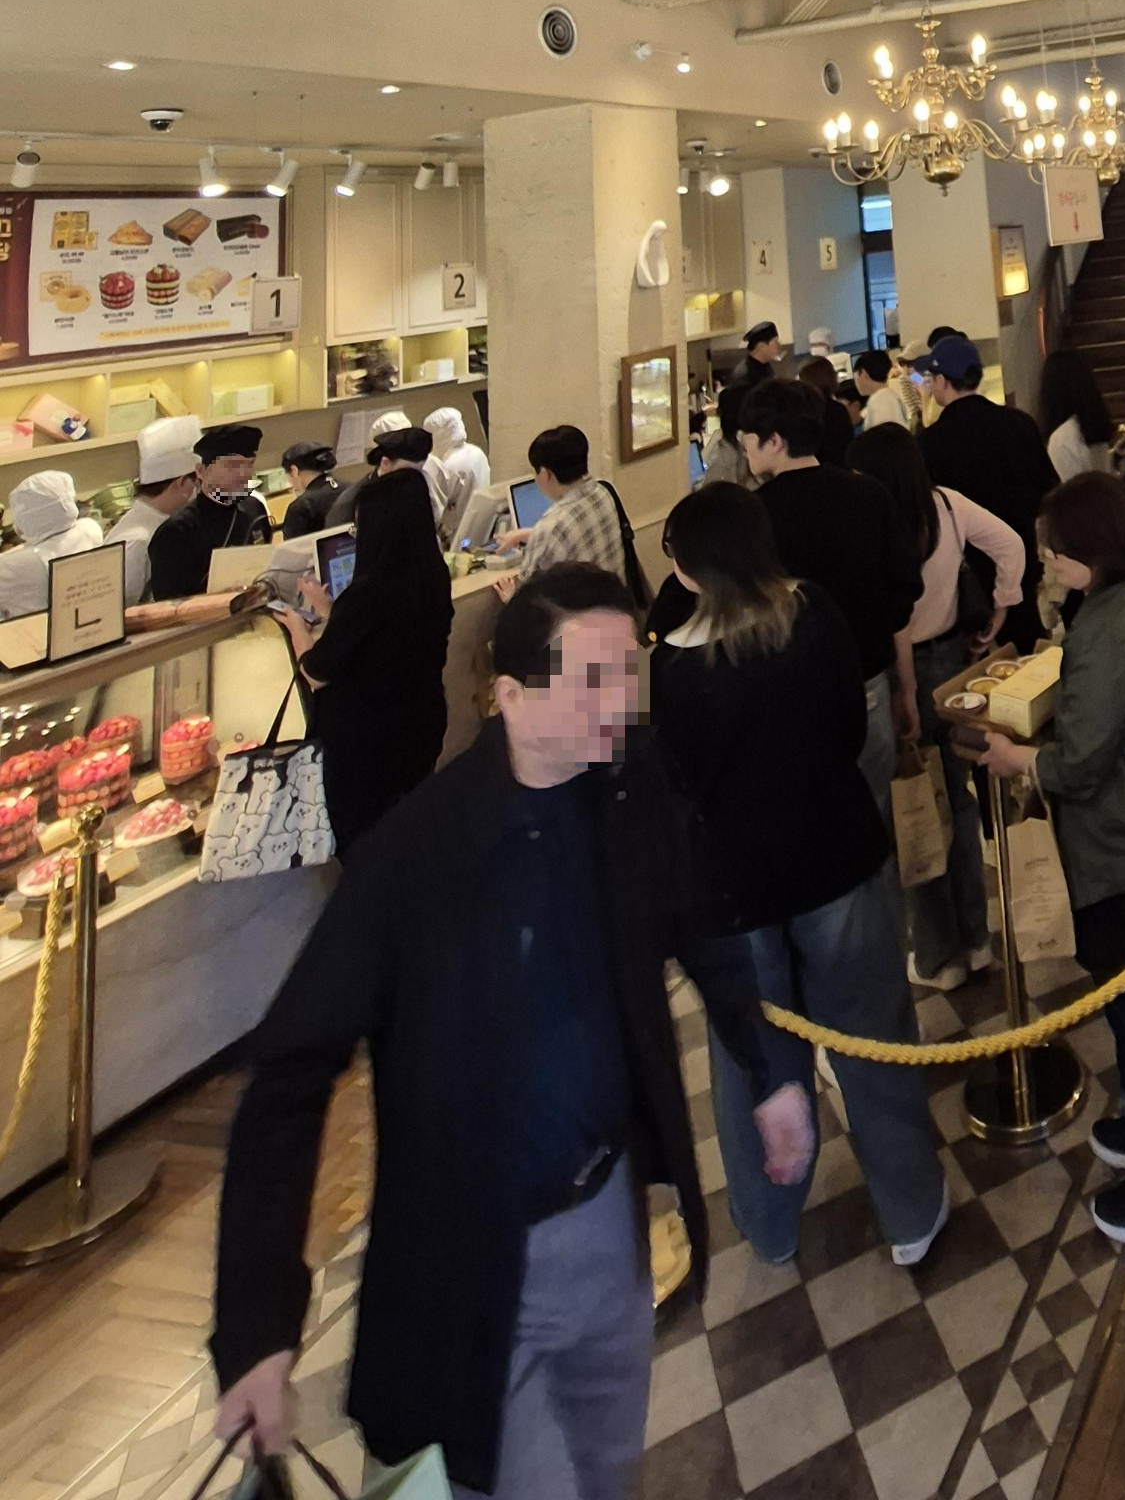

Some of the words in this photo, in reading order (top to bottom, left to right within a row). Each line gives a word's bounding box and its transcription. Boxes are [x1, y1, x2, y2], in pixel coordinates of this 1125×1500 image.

[759, 249, 767, 267] 4
[825, 244, 833, 262] 5
[454, 273, 466, 299] 2
[269, 288, 281, 318] 1
